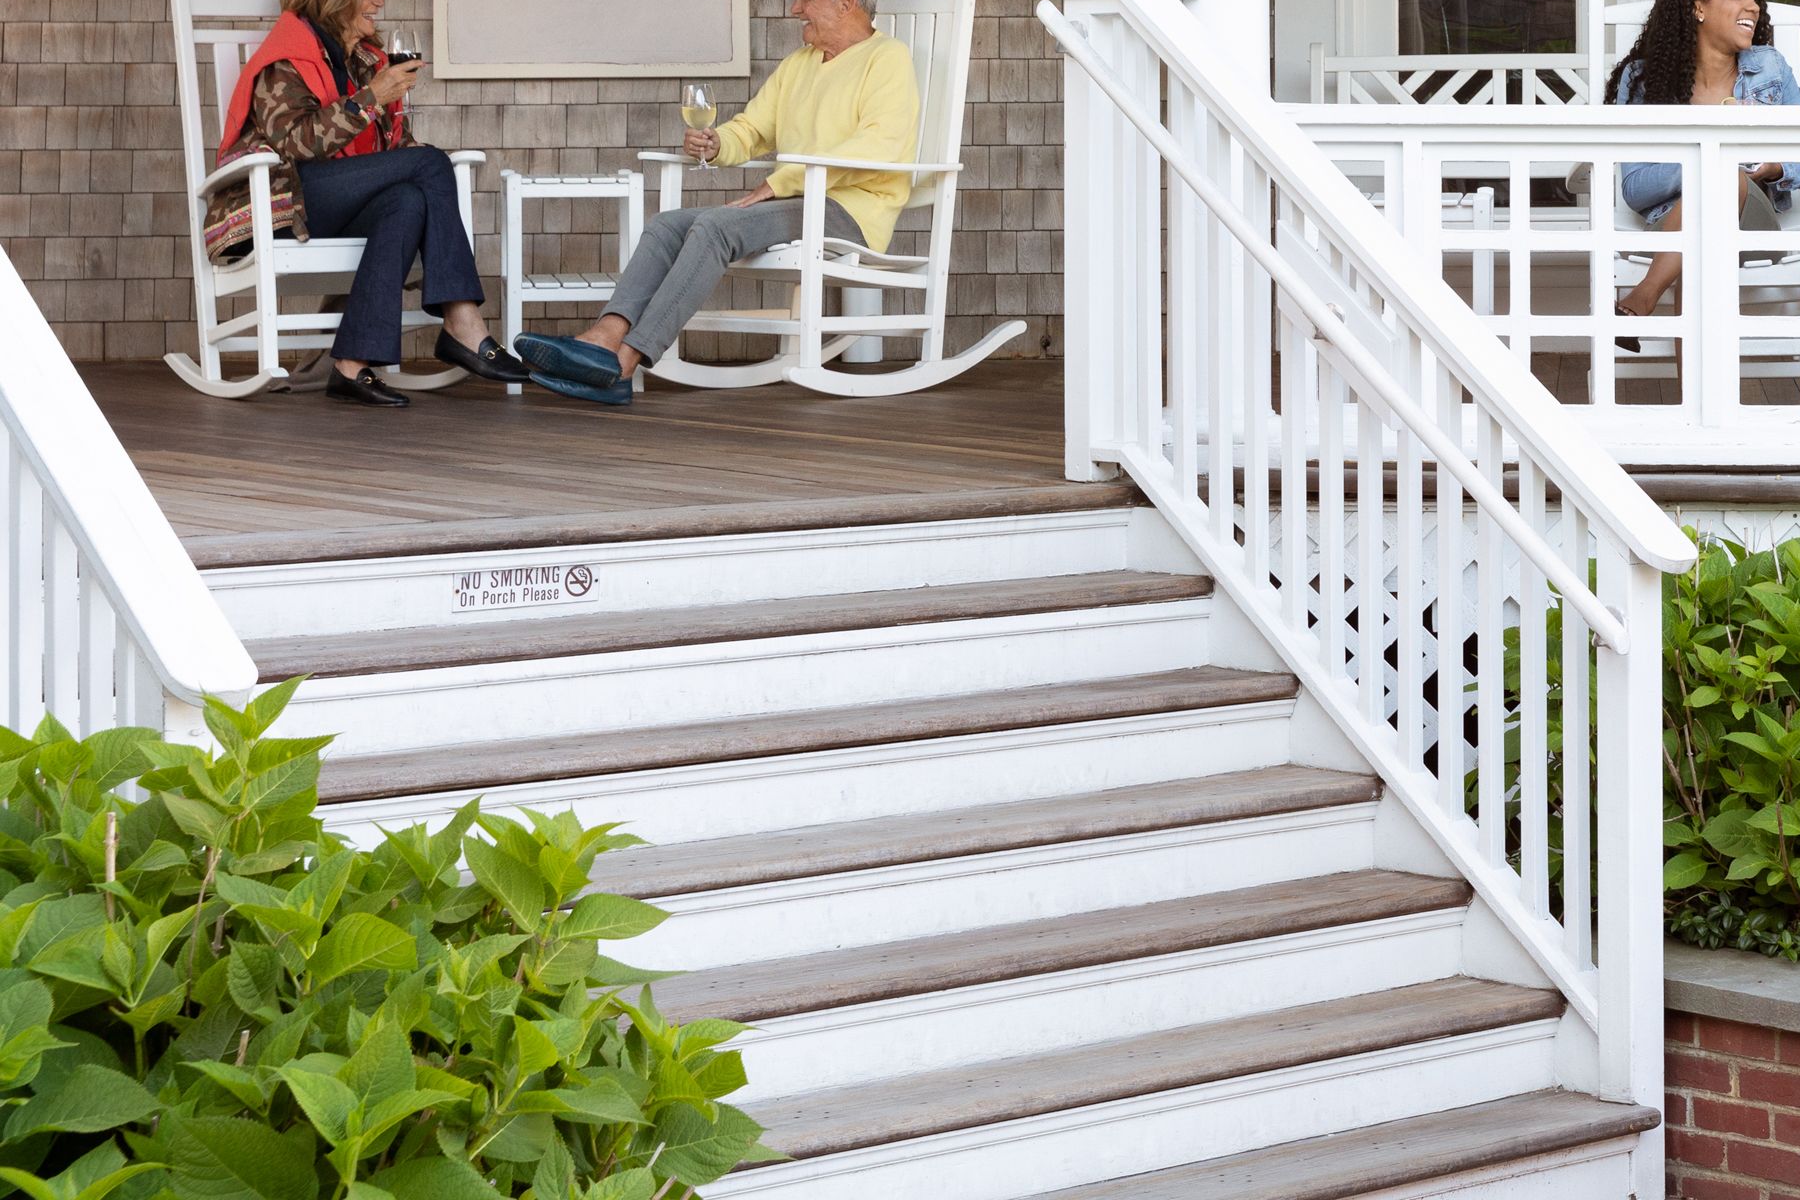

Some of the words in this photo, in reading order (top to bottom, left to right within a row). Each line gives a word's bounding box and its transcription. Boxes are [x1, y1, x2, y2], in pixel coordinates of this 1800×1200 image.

[460, 571, 482, 590] NO
[490, 566, 561, 589] SMOKING
[460, 592, 475, 607] On
[482, 590, 516, 605] Porch
[522, 588, 560, 601] Please
